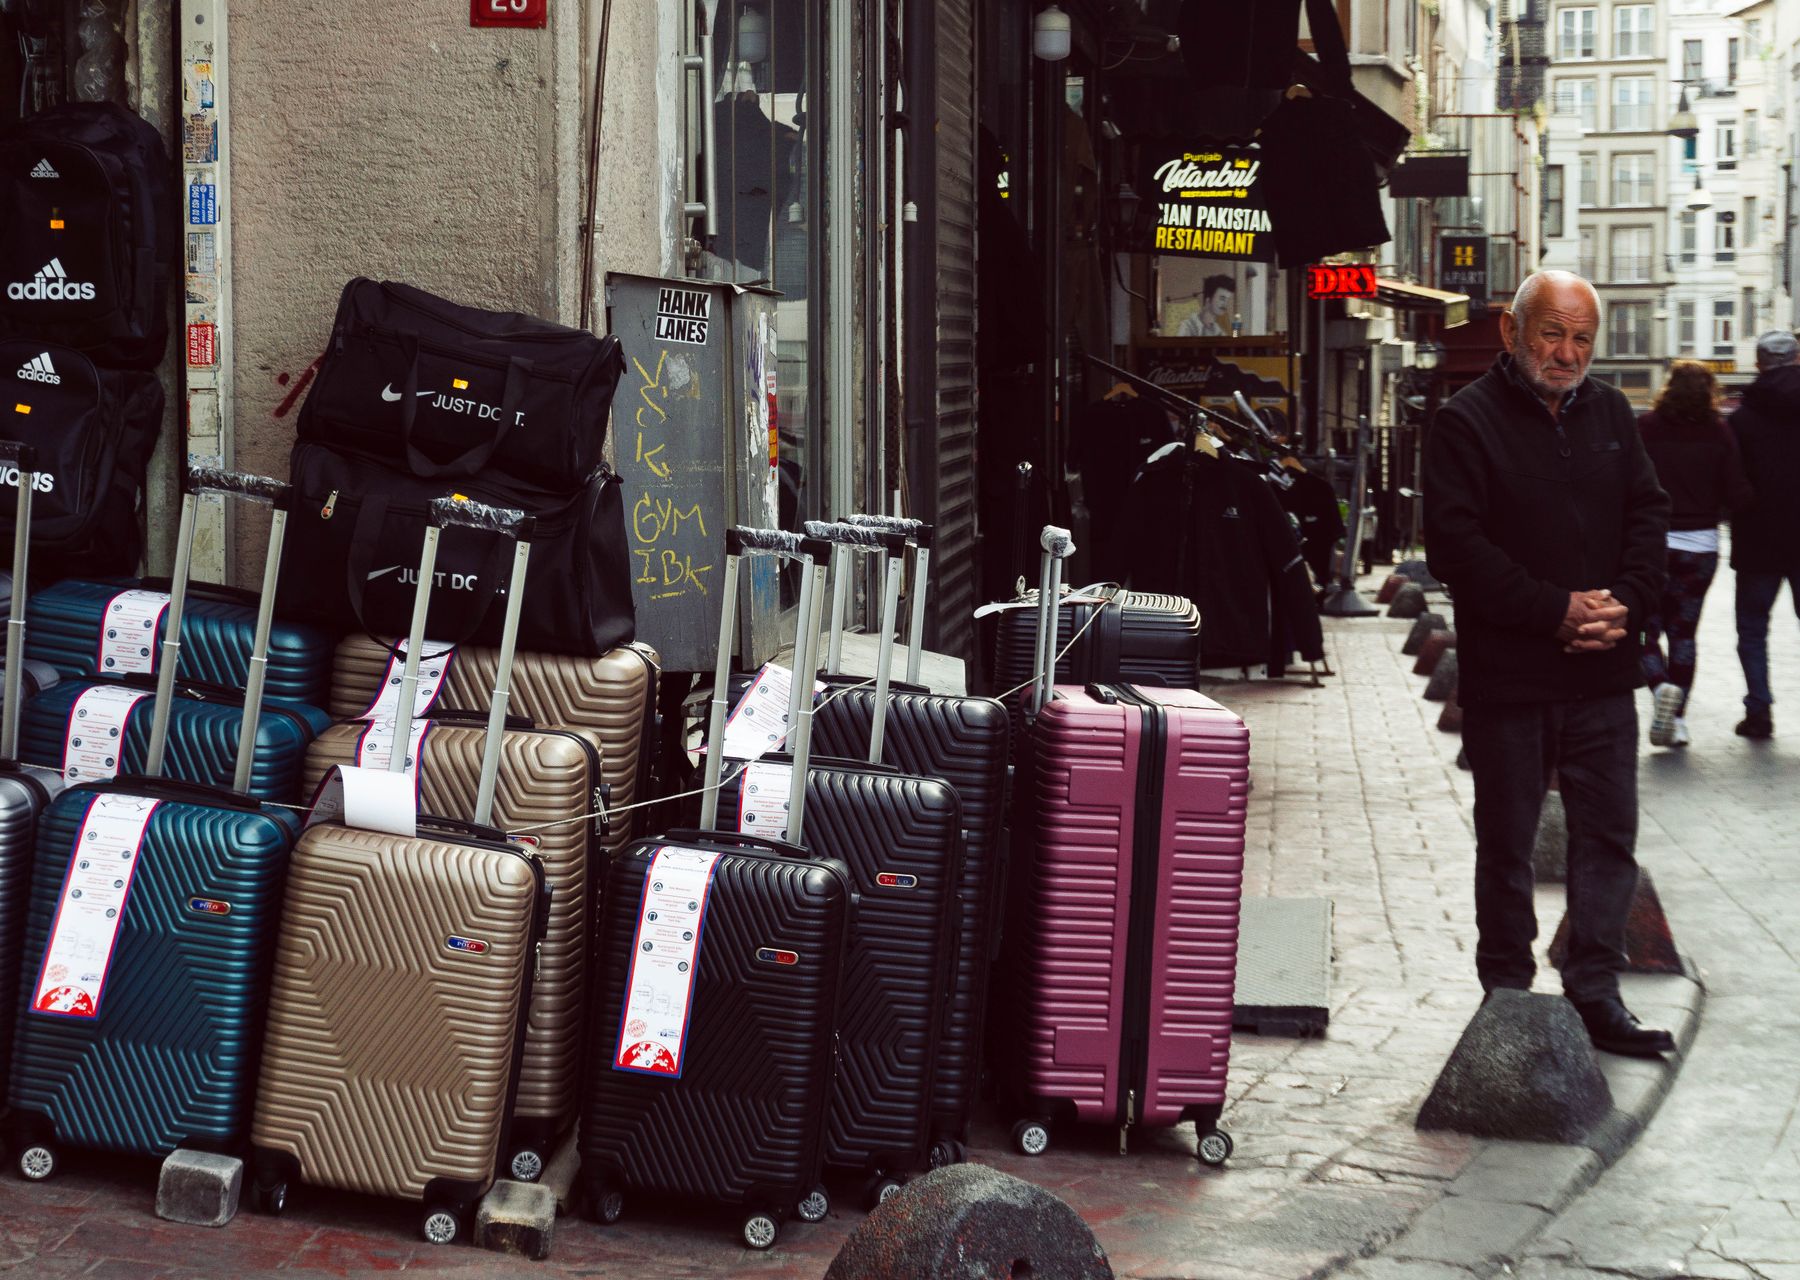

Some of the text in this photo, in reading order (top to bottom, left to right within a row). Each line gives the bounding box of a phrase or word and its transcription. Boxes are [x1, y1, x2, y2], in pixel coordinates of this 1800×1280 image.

[1183, 152, 1222, 163] Punjab
[30, 170, 60, 178] adidas
[1155, 226, 1256, 255] RESTAURANT
[7, 277, 96, 300] adidas
[1313, 267, 1376, 294] DRY
[658, 289, 710, 317] HANK
[655, 317, 707, 344] LANES
[17, 369, 61, 385] adidas
[432, 394, 477, 415] JUST
[633, 492, 707, 543] GYM
[397, 568, 447, 588] JUT
[883, 877, 910, 886] POLO
[198, 901, 219, 911] POLO
[456, 940, 477, 950] POLO
[764, 951, 790, 961] POLO
